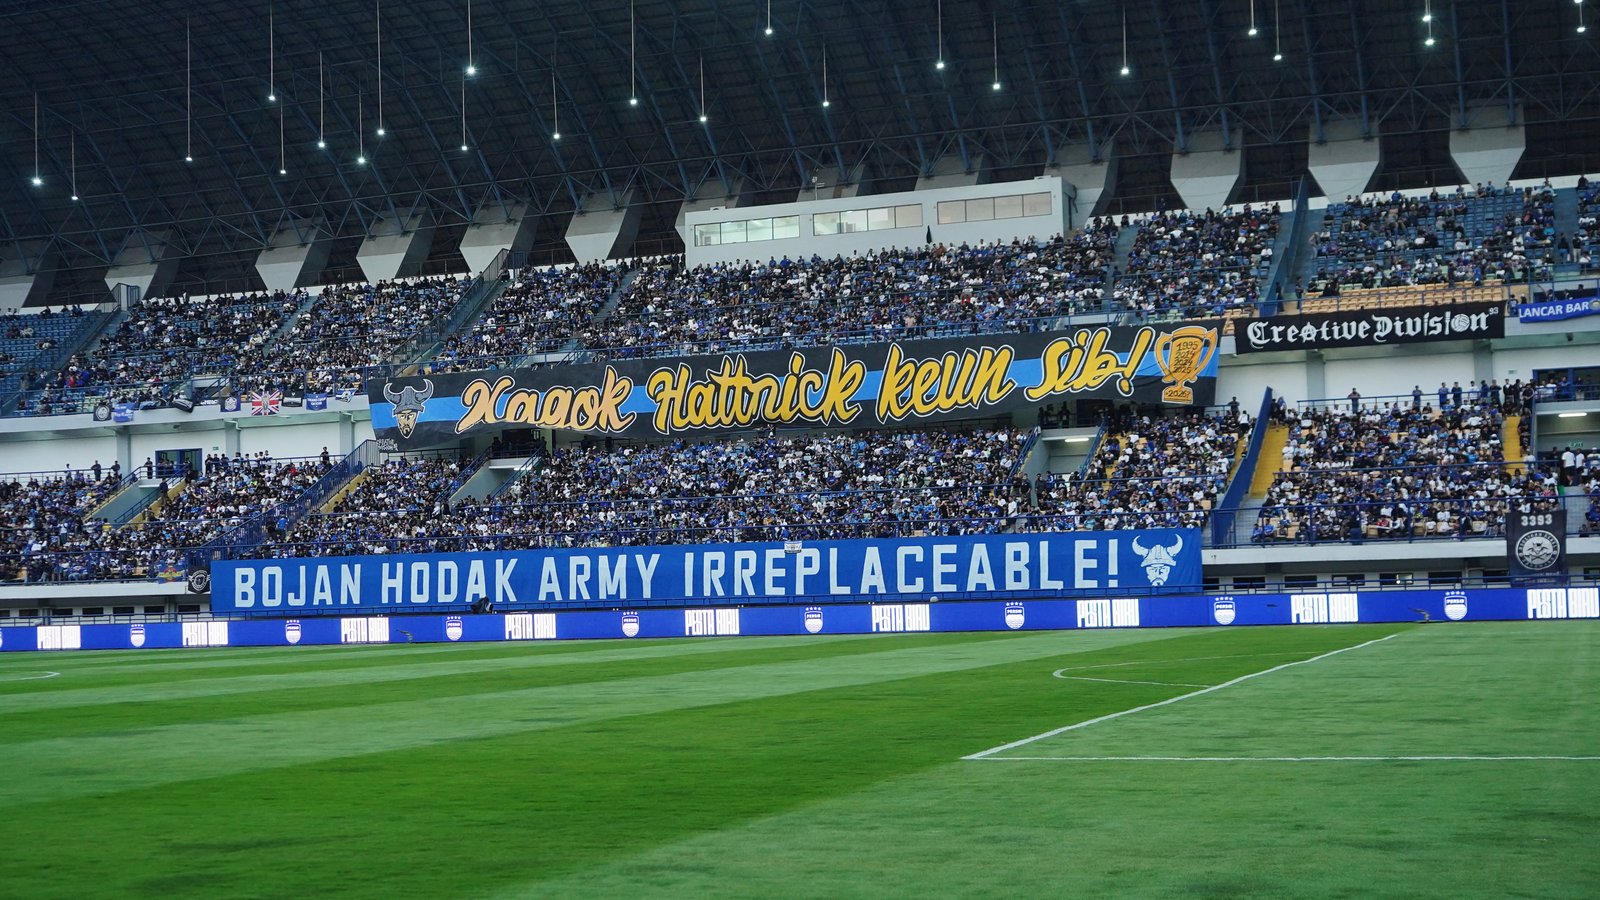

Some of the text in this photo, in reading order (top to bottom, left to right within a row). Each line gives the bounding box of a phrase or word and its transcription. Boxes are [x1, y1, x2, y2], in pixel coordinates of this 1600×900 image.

[1518, 301, 1590, 319] LANCAR BAR
[1176, 341, 1199, 351] 1995
[1175, 350, 1196, 359] 2014
[1172, 366, 1192, 374] 2025
[1174, 358, 1194, 367] 2024
[1521, 514, 1552, 526] 3393
[235, 564, 361, 608] BOJAN
[382, 559, 518, 604] HODAK
[539, 554, 660, 601] ARMY
[685, 538, 1118, 597] IRREPLACEABLE!
[872, 604, 903, 631] PESTA
[1077, 599, 1111, 627] PESTA
[685, 609, 714, 635] PESTA
